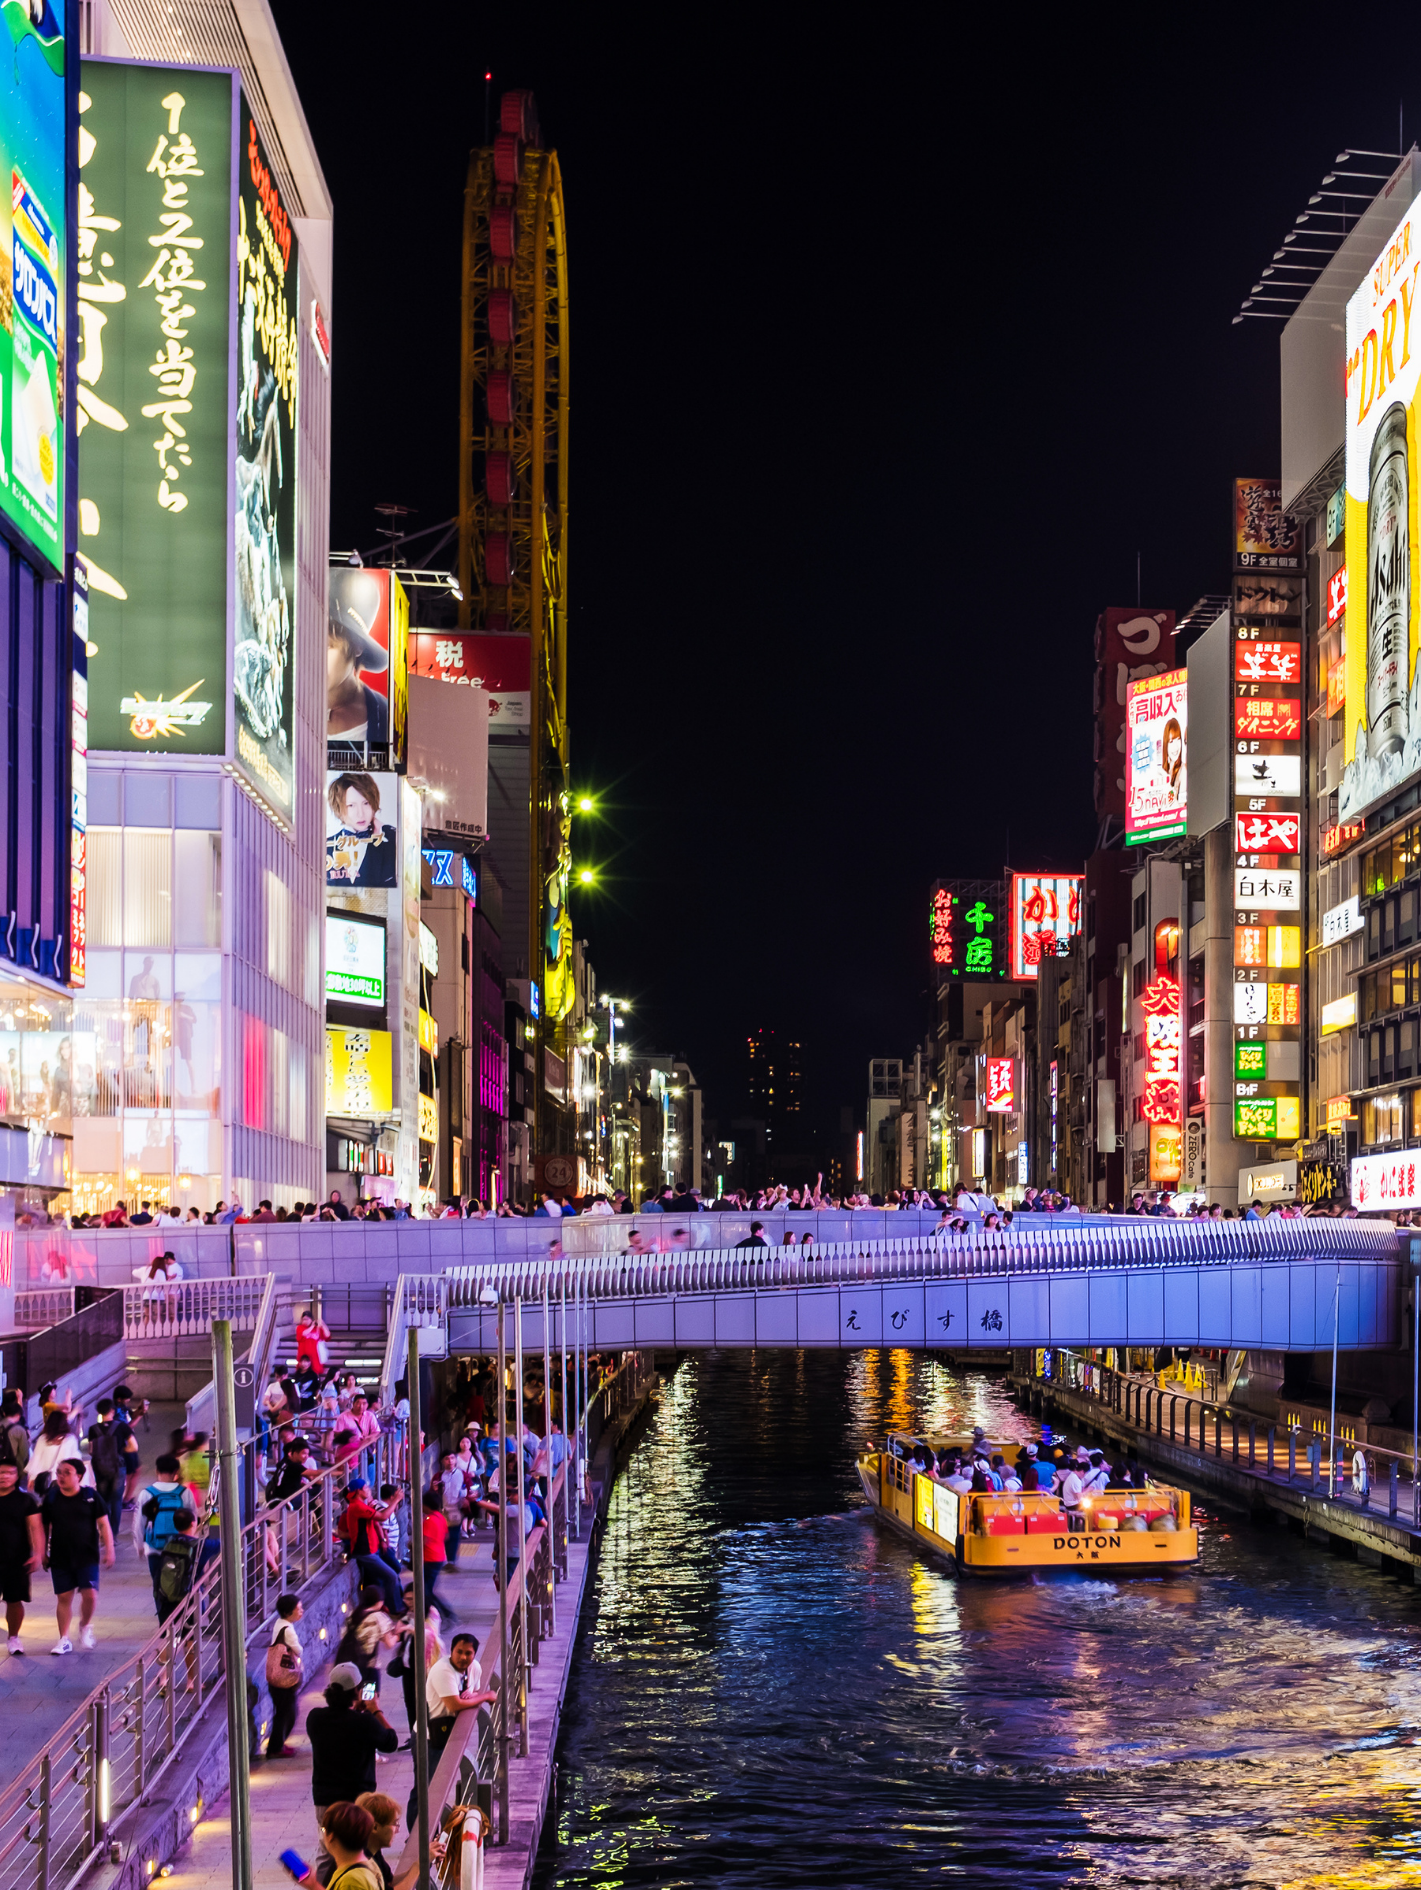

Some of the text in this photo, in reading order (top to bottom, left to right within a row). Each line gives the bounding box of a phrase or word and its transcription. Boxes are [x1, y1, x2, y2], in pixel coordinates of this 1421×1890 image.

[1241, 552, 1257, 565] 9F
[1382, 627, 1393, 662] 生
[435, 641, 464, 668] 税
[1135, 692, 1177, 724] 高収入
[1246, 702, 1274, 717] 相席
[1238, 717, 1300, 736] ダイニング
[1249, 798, 1266, 811] 5F
[445, 819, 483, 834] 意匠作成中
[1238, 818, 1298, 850] はや
[1239, 876, 1295, 898] 白木屋
[934, 888, 953, 964] お好み焼
[965, 901, 994, 966] 千房
[1236, 1083, 1259, 1096] B1F
[1239, 1107, 1273, 1122] びっくり
[1238, 1121, 1276, 1136] ドンキー
[552, 1166, 566, 1179] 24
[846, 1310, 1003, 1331] えびす橋
[1054, 1536, 1121, 1551] DOTON
